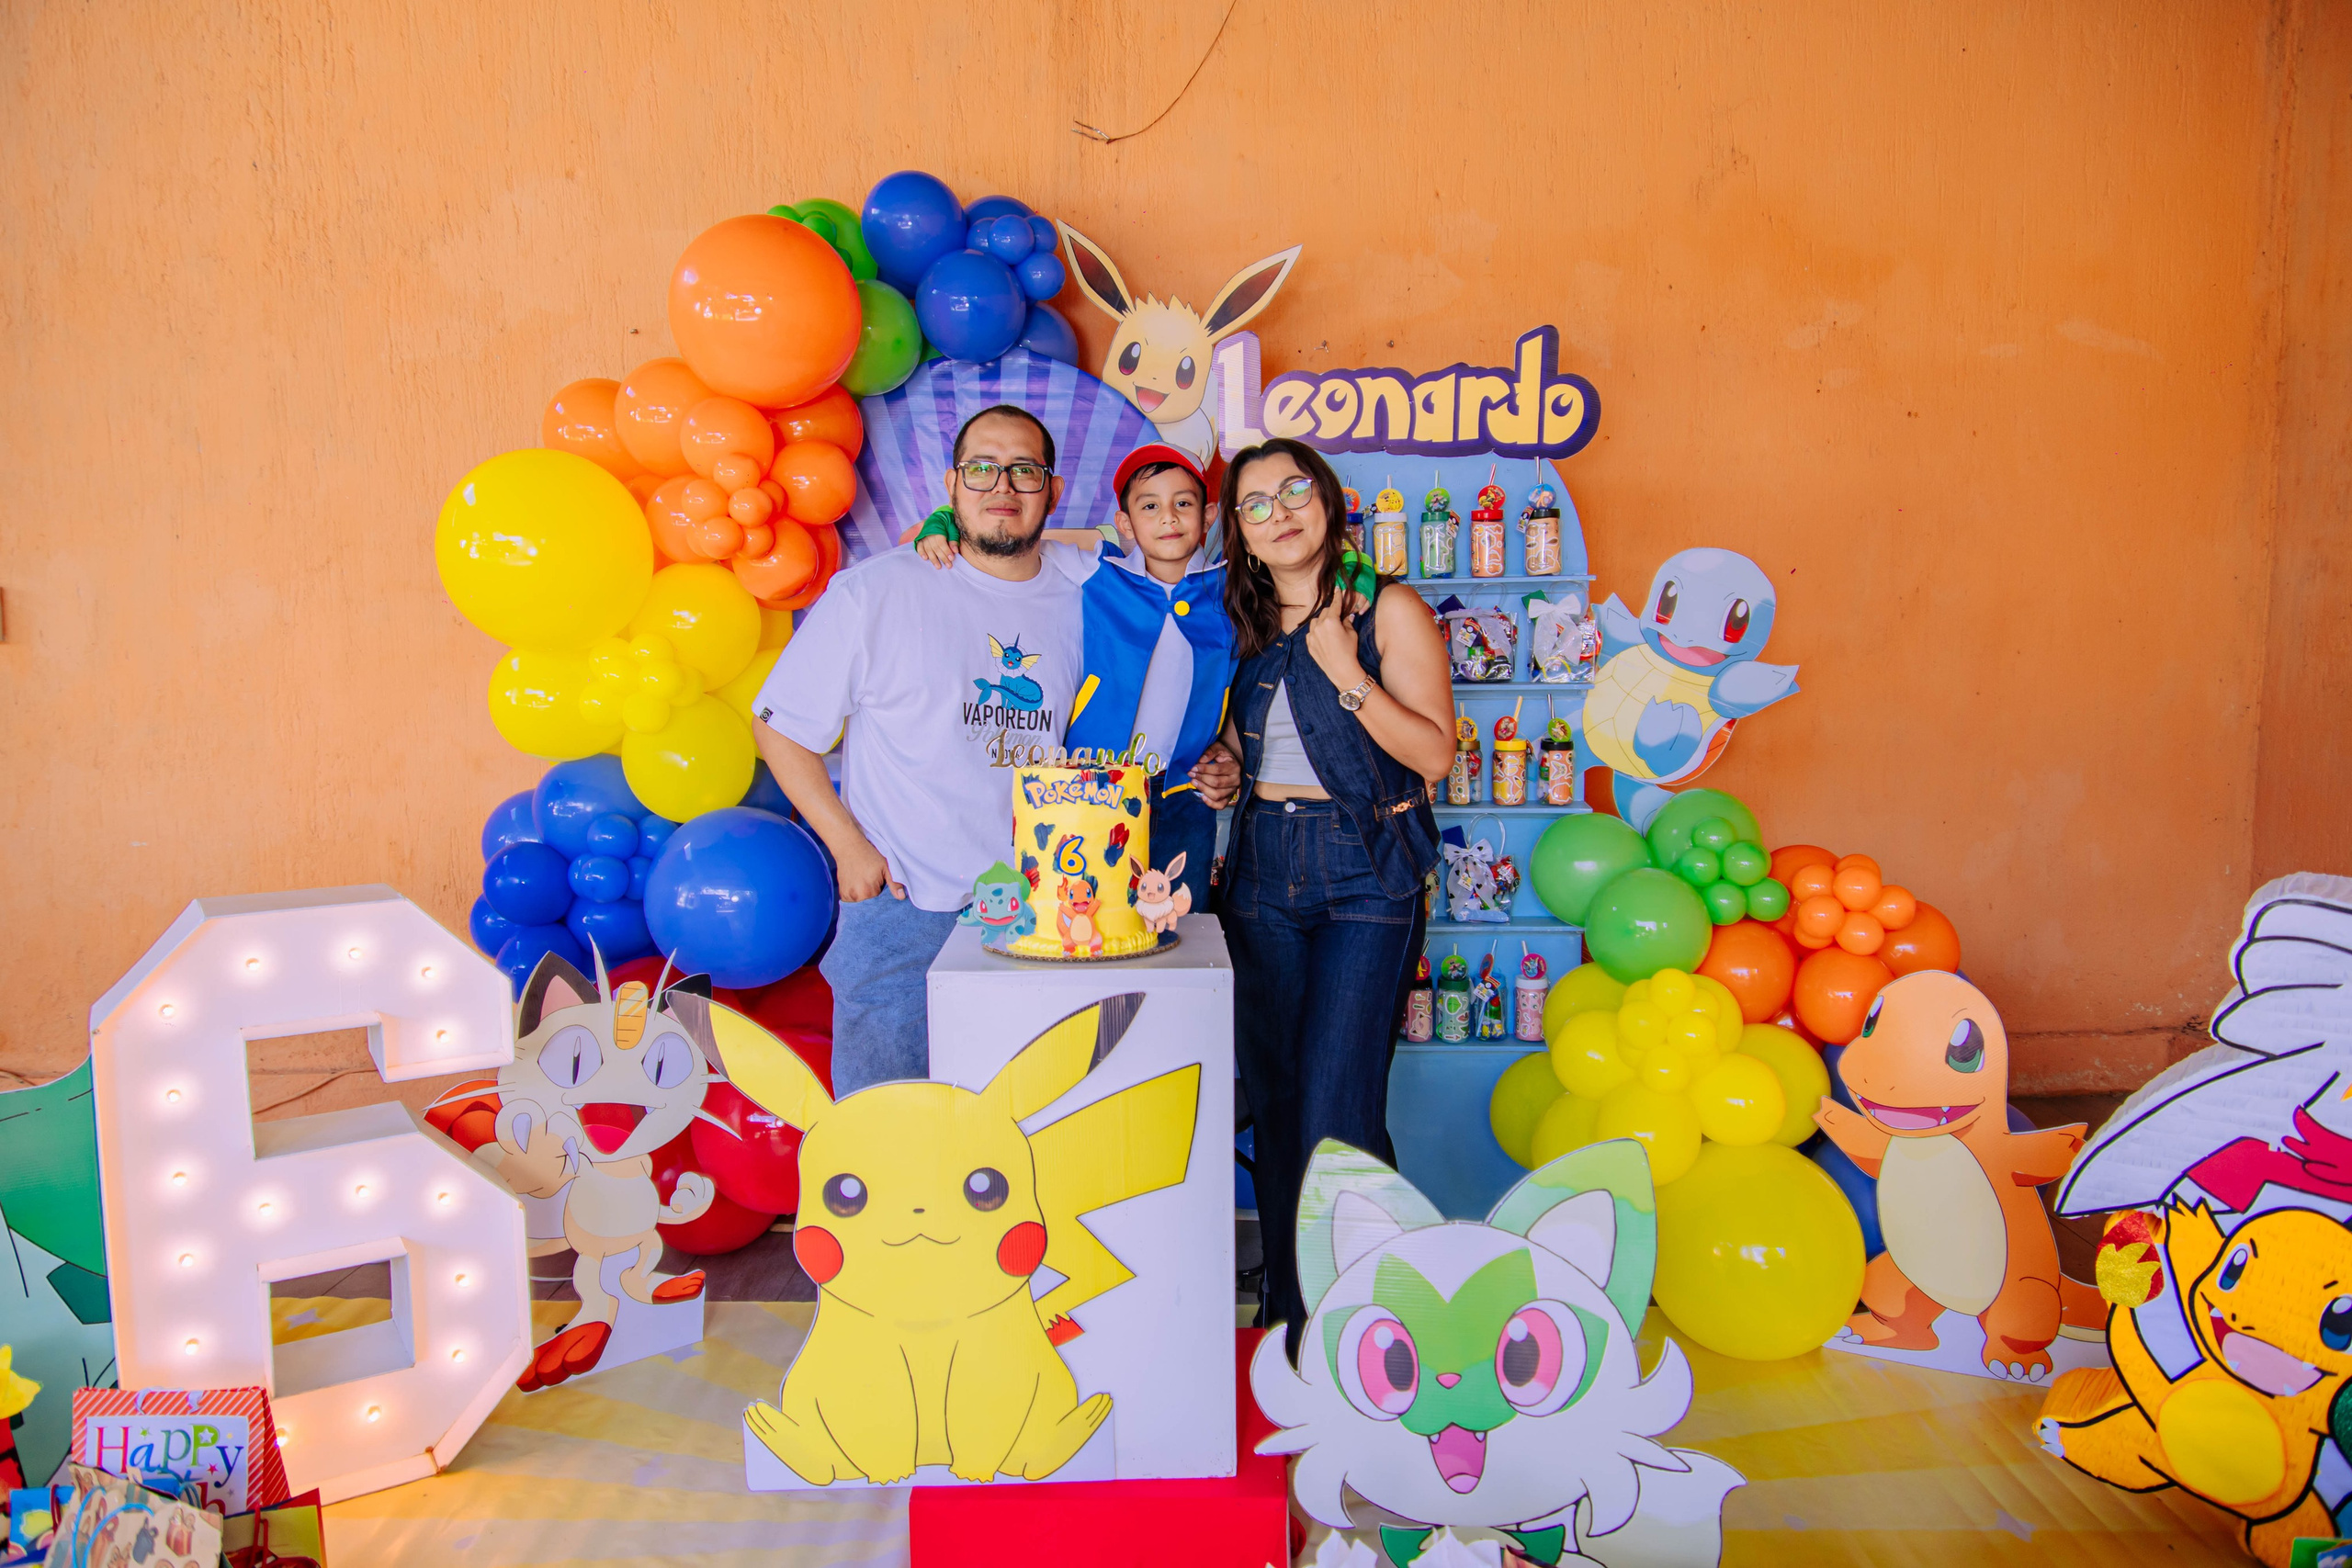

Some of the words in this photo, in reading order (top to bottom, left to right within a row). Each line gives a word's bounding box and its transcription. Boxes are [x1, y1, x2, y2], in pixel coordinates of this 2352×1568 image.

[1216, 334, 1586, 450] Leonardo
[963, 703, 1053, 732] VAPOREON
[986, 728, 1167, 776] Leonardo
[1057, 835, 1087, 876] 6
[91, 884, 533, 1506] 6
